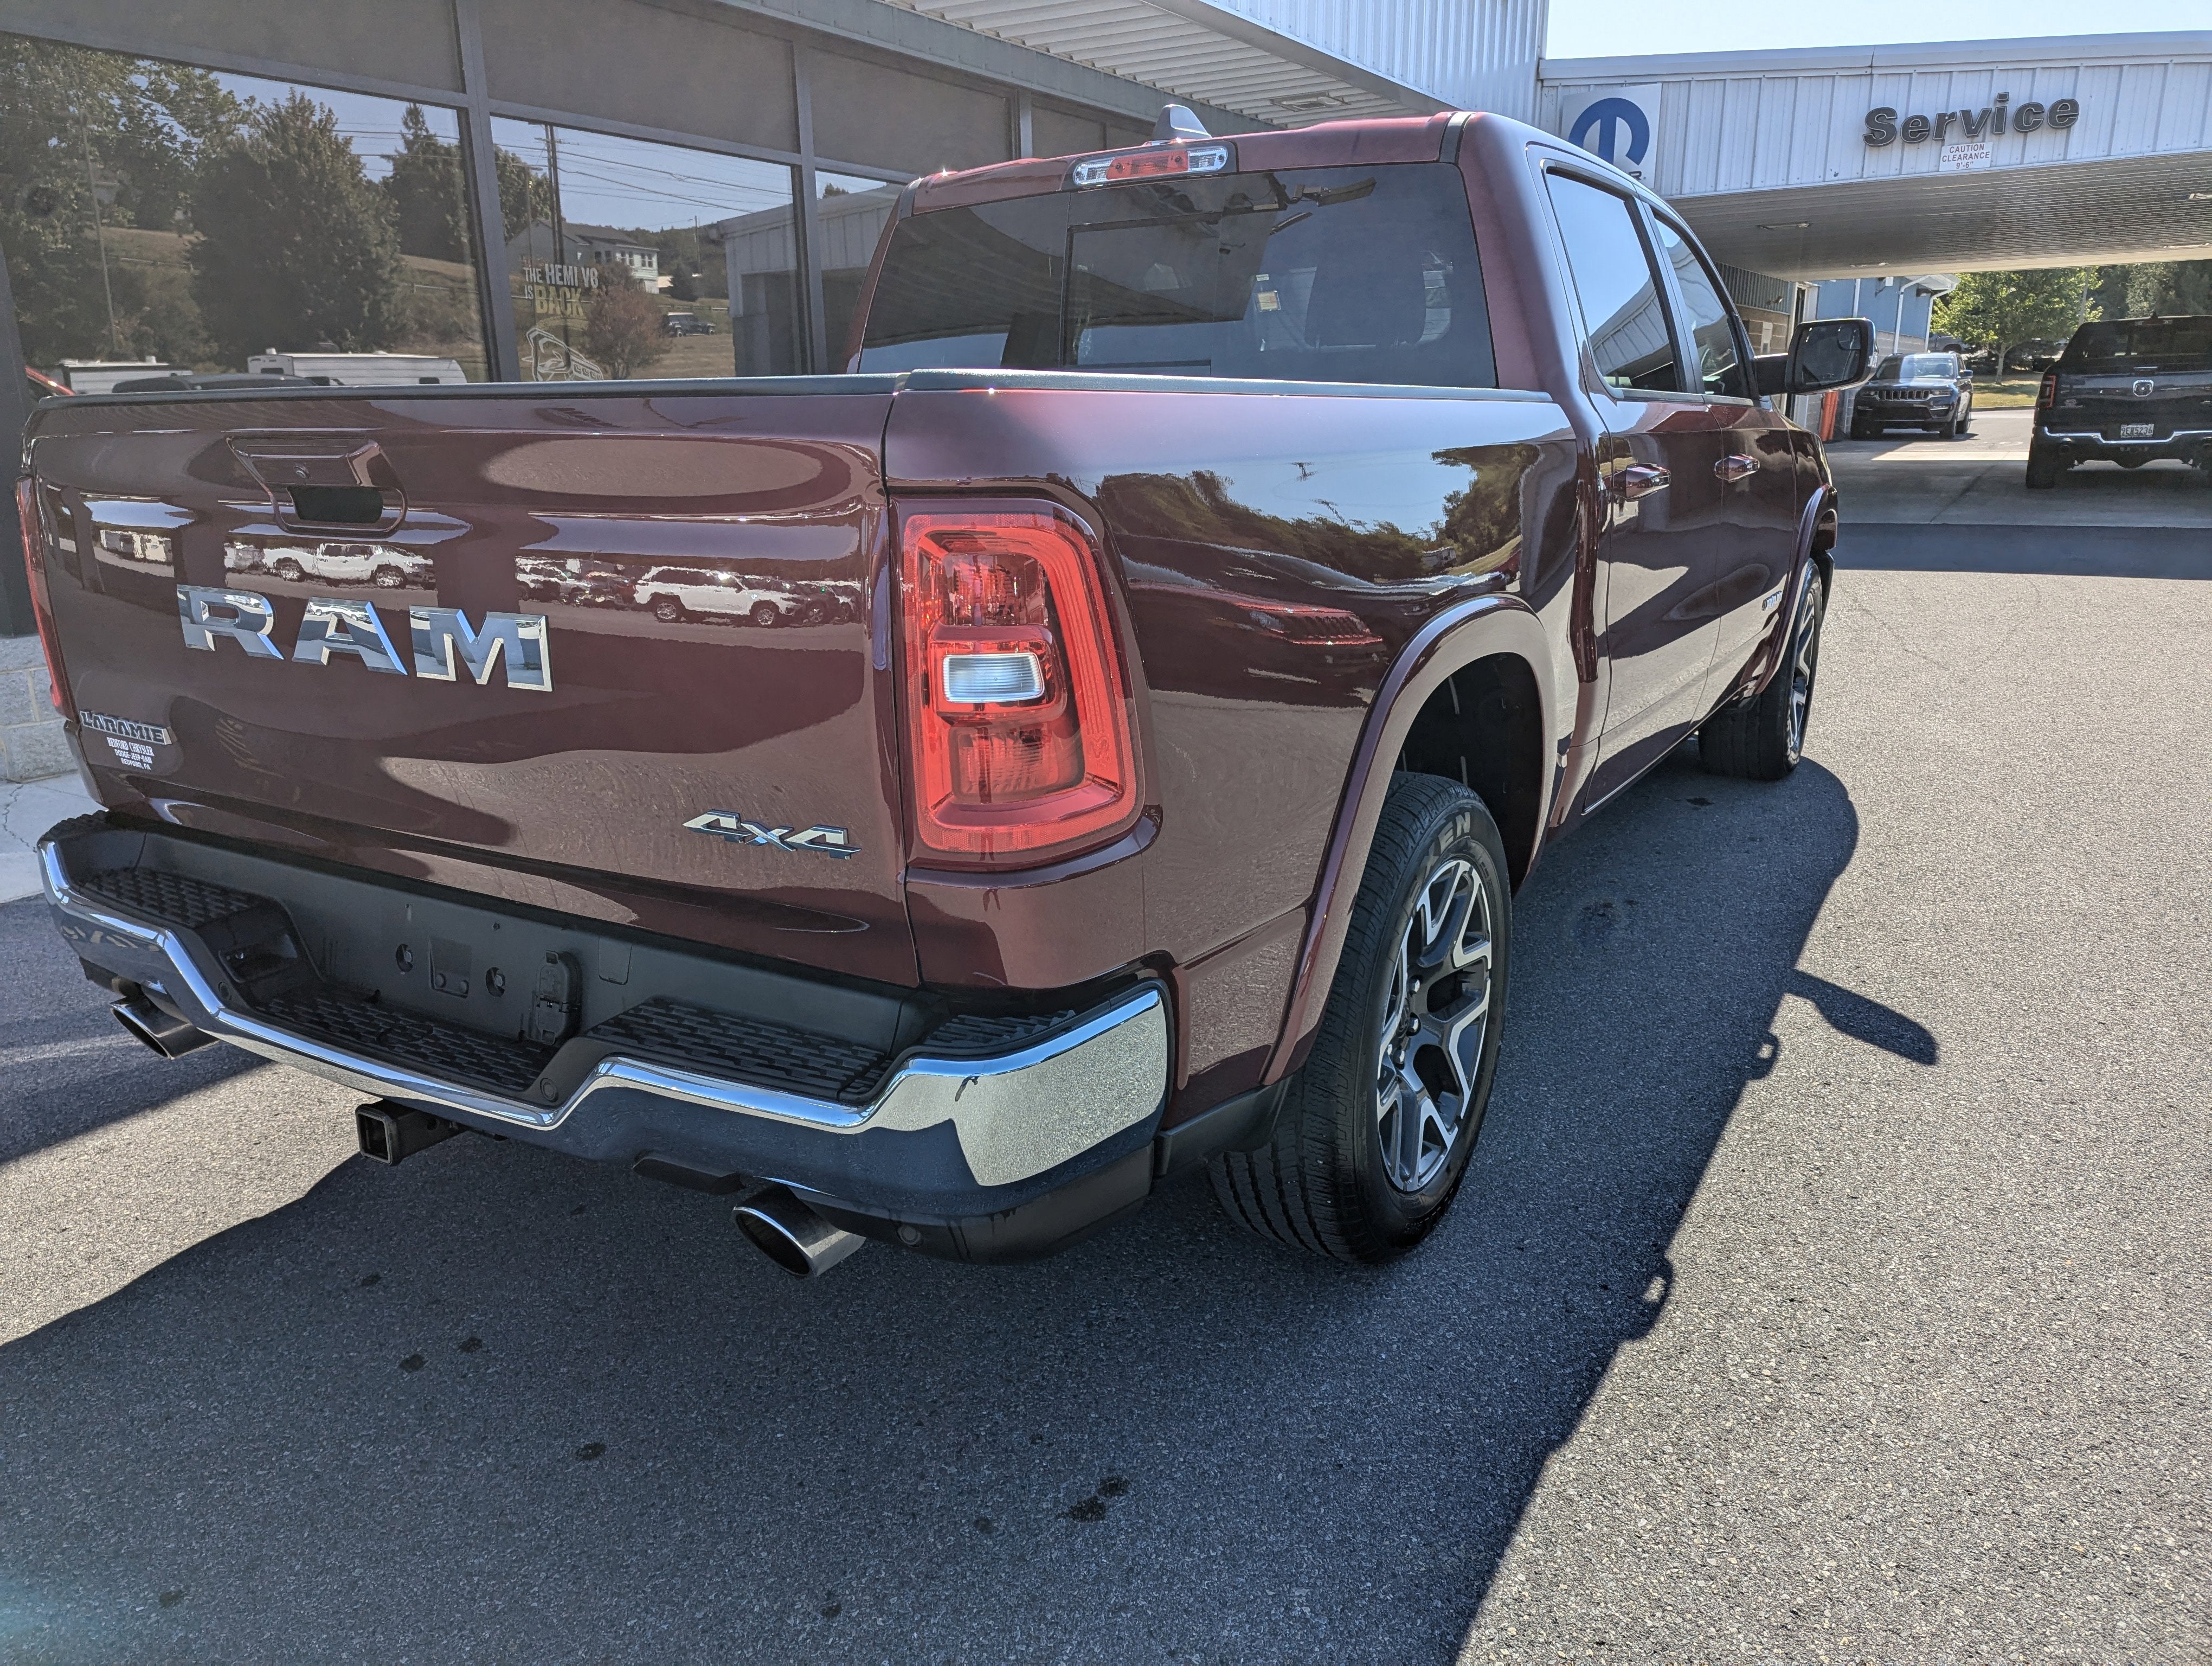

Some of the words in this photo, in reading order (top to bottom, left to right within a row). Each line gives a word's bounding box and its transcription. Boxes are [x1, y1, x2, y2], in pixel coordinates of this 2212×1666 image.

[1863, 92, 2080, 146] Service
[1942, 151, 1990, 162] CLEARANCE
[1950, 143, 1985, 153] CAUTION
[523, 267, 543, 283] THE
[545, 264, 579, 286] HEMI
[581, 267, 599, 289] V8
[524, 285, 534, 300] IS
[533, 284, 584, 318] BACK
[177, 584, 552, 692] RAM
[80, 710, 167, 745] LARAMIE
[107, 736, 129, 751] BEDFORD
[129, 741, 155, 757] CHRYSLER
